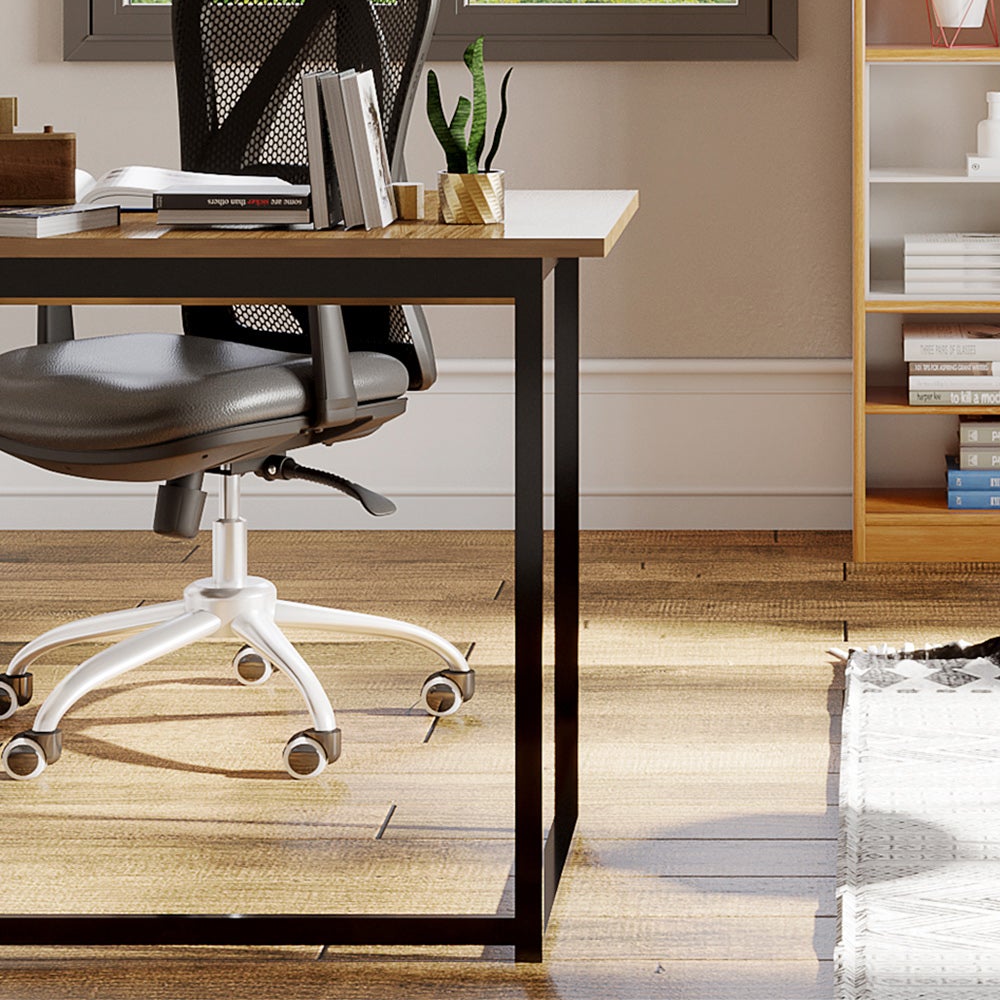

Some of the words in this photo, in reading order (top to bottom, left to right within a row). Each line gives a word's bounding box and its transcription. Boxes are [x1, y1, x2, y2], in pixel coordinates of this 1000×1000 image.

[951, 392, 959, 403] to
[961, 391, 972, 403] kill
[974, 394, 979, 404] a
